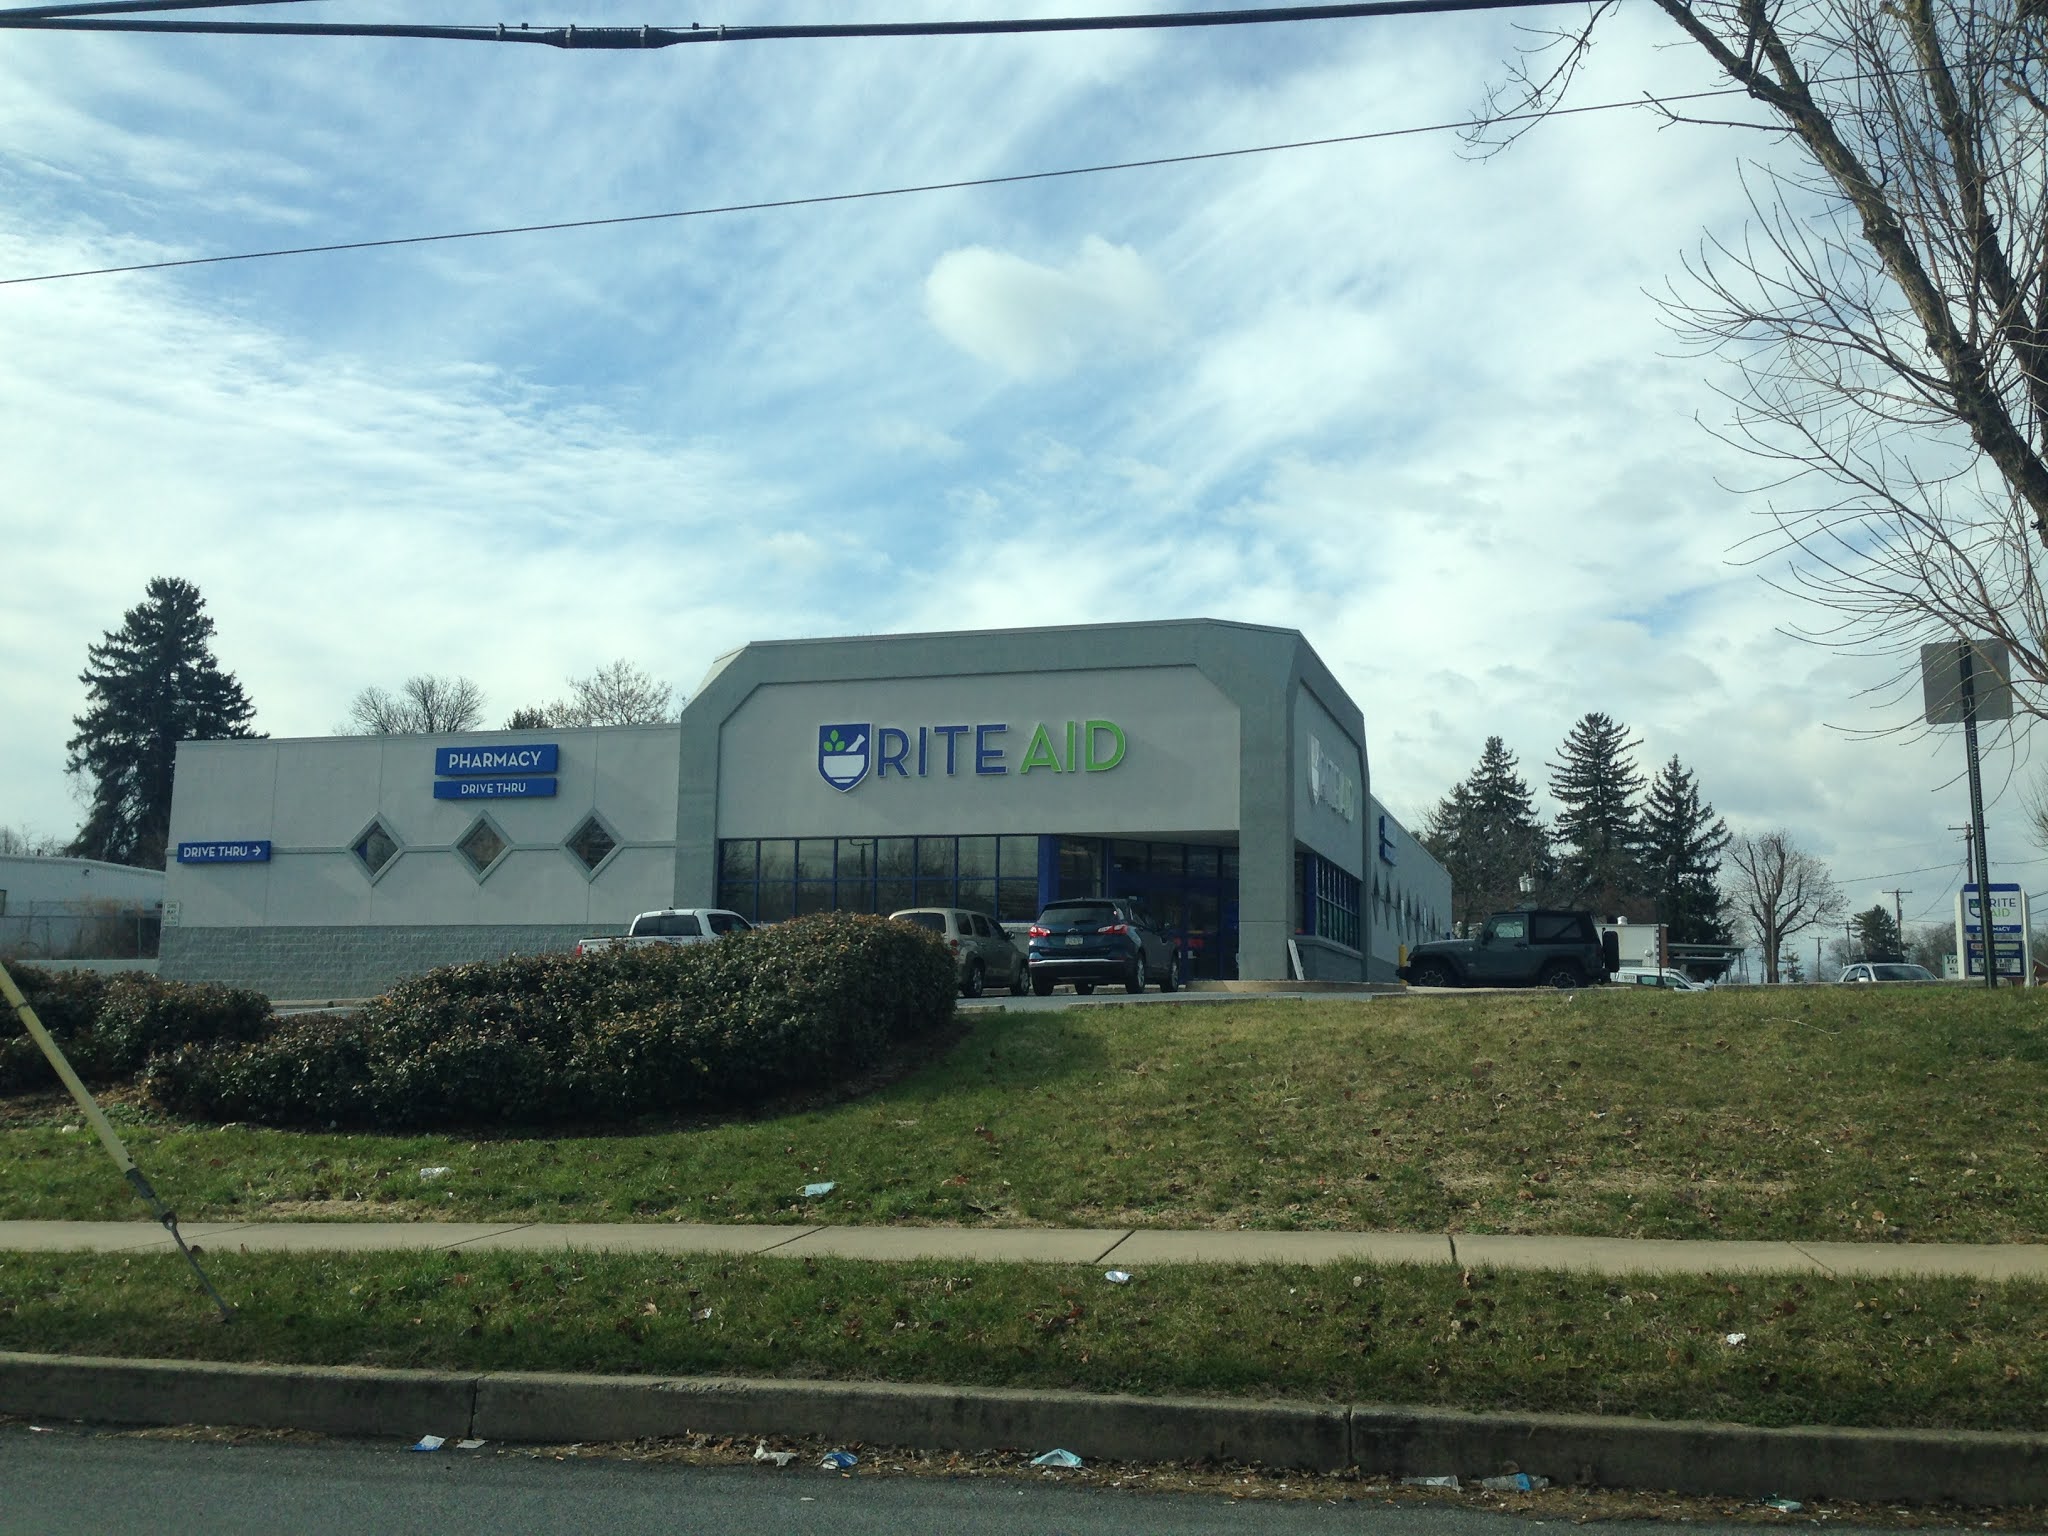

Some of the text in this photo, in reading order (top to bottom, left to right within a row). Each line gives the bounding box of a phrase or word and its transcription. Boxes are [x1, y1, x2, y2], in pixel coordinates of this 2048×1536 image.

[876, 719, 1127, 778] RITE AID
[448, 751, 541, 769] PHARMACY
[461, 782, 526, 794] DRIVE THRU
[183, 846, 248, 858] DRIVE THRU
[1990, 898, 2016, 907] RITE
[1992, 908, 2010, 917] AID
